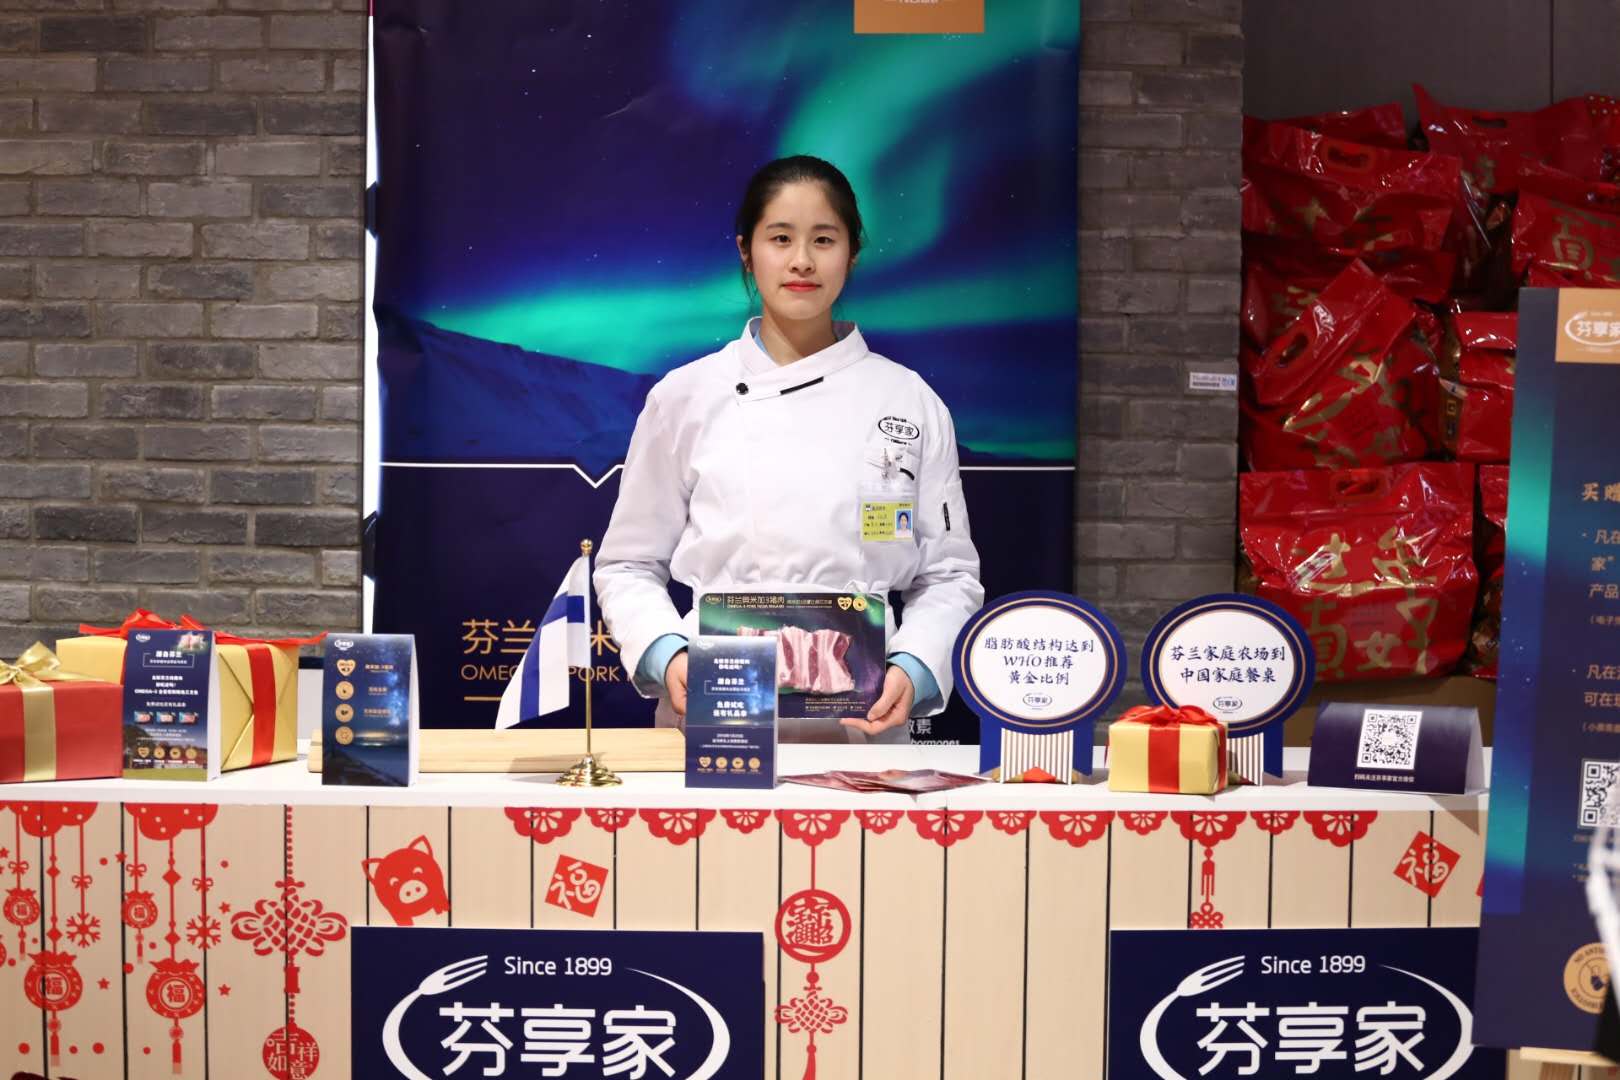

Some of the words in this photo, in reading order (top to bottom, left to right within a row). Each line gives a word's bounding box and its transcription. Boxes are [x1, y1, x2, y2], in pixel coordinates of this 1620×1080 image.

[1588, 583, 1620, 599] 产品
[984, 636, 1095, 653] 脂肪酸结构达到
[1170, 645, 1286, 662] 芬兰家庭农场到
[569, 664, 620, 682] PORK
[1008, 670, 1071, 687] 黄金比例
[1180, 667, 1277, 685] 中国家庭餐桌
[1586, 664, 1620, 680] 凡在
[504, 956, 557, 976] Since
[564, 957, 613, 977] 1899
[1260, 955, 1312, 975] Since
[1319, 955, 1366, 974] 1899
[45, 976, 63, 996] 福
[166, 983, 186, 1003] 福
[439, 1002, 677, 1080] 芬享家
[1196, 1001, 1427, 1077] 芬享家
